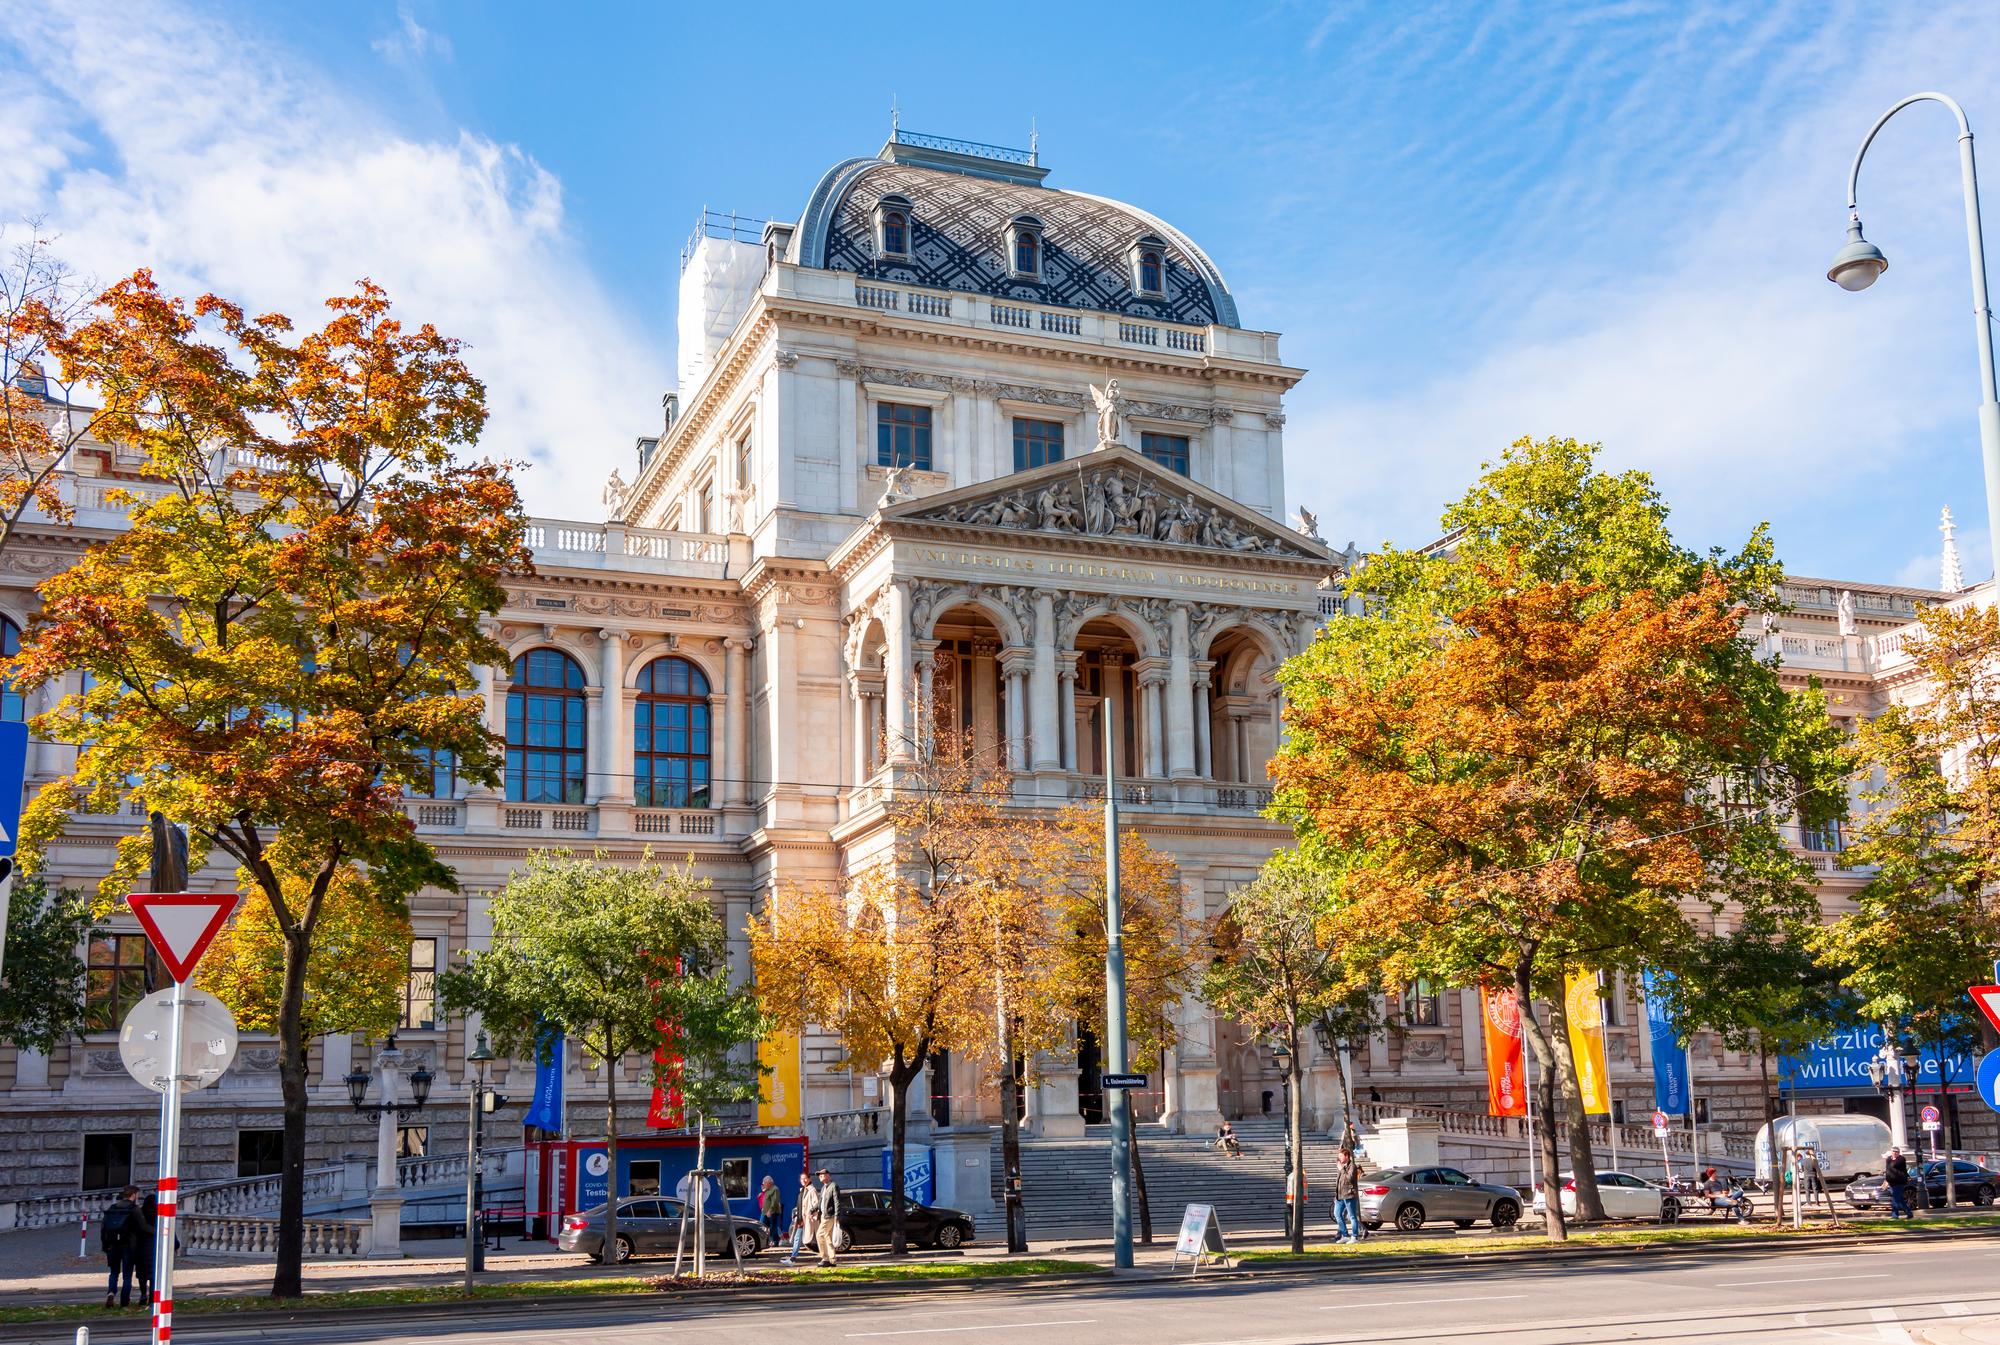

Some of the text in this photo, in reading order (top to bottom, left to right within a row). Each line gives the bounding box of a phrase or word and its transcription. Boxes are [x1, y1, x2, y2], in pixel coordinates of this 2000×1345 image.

[1801, 1028, 1889, 1051] erzlic
[1800, 1053, 1963, 1079] willkoen!
[585, 1189, 608, 1197] Testb
